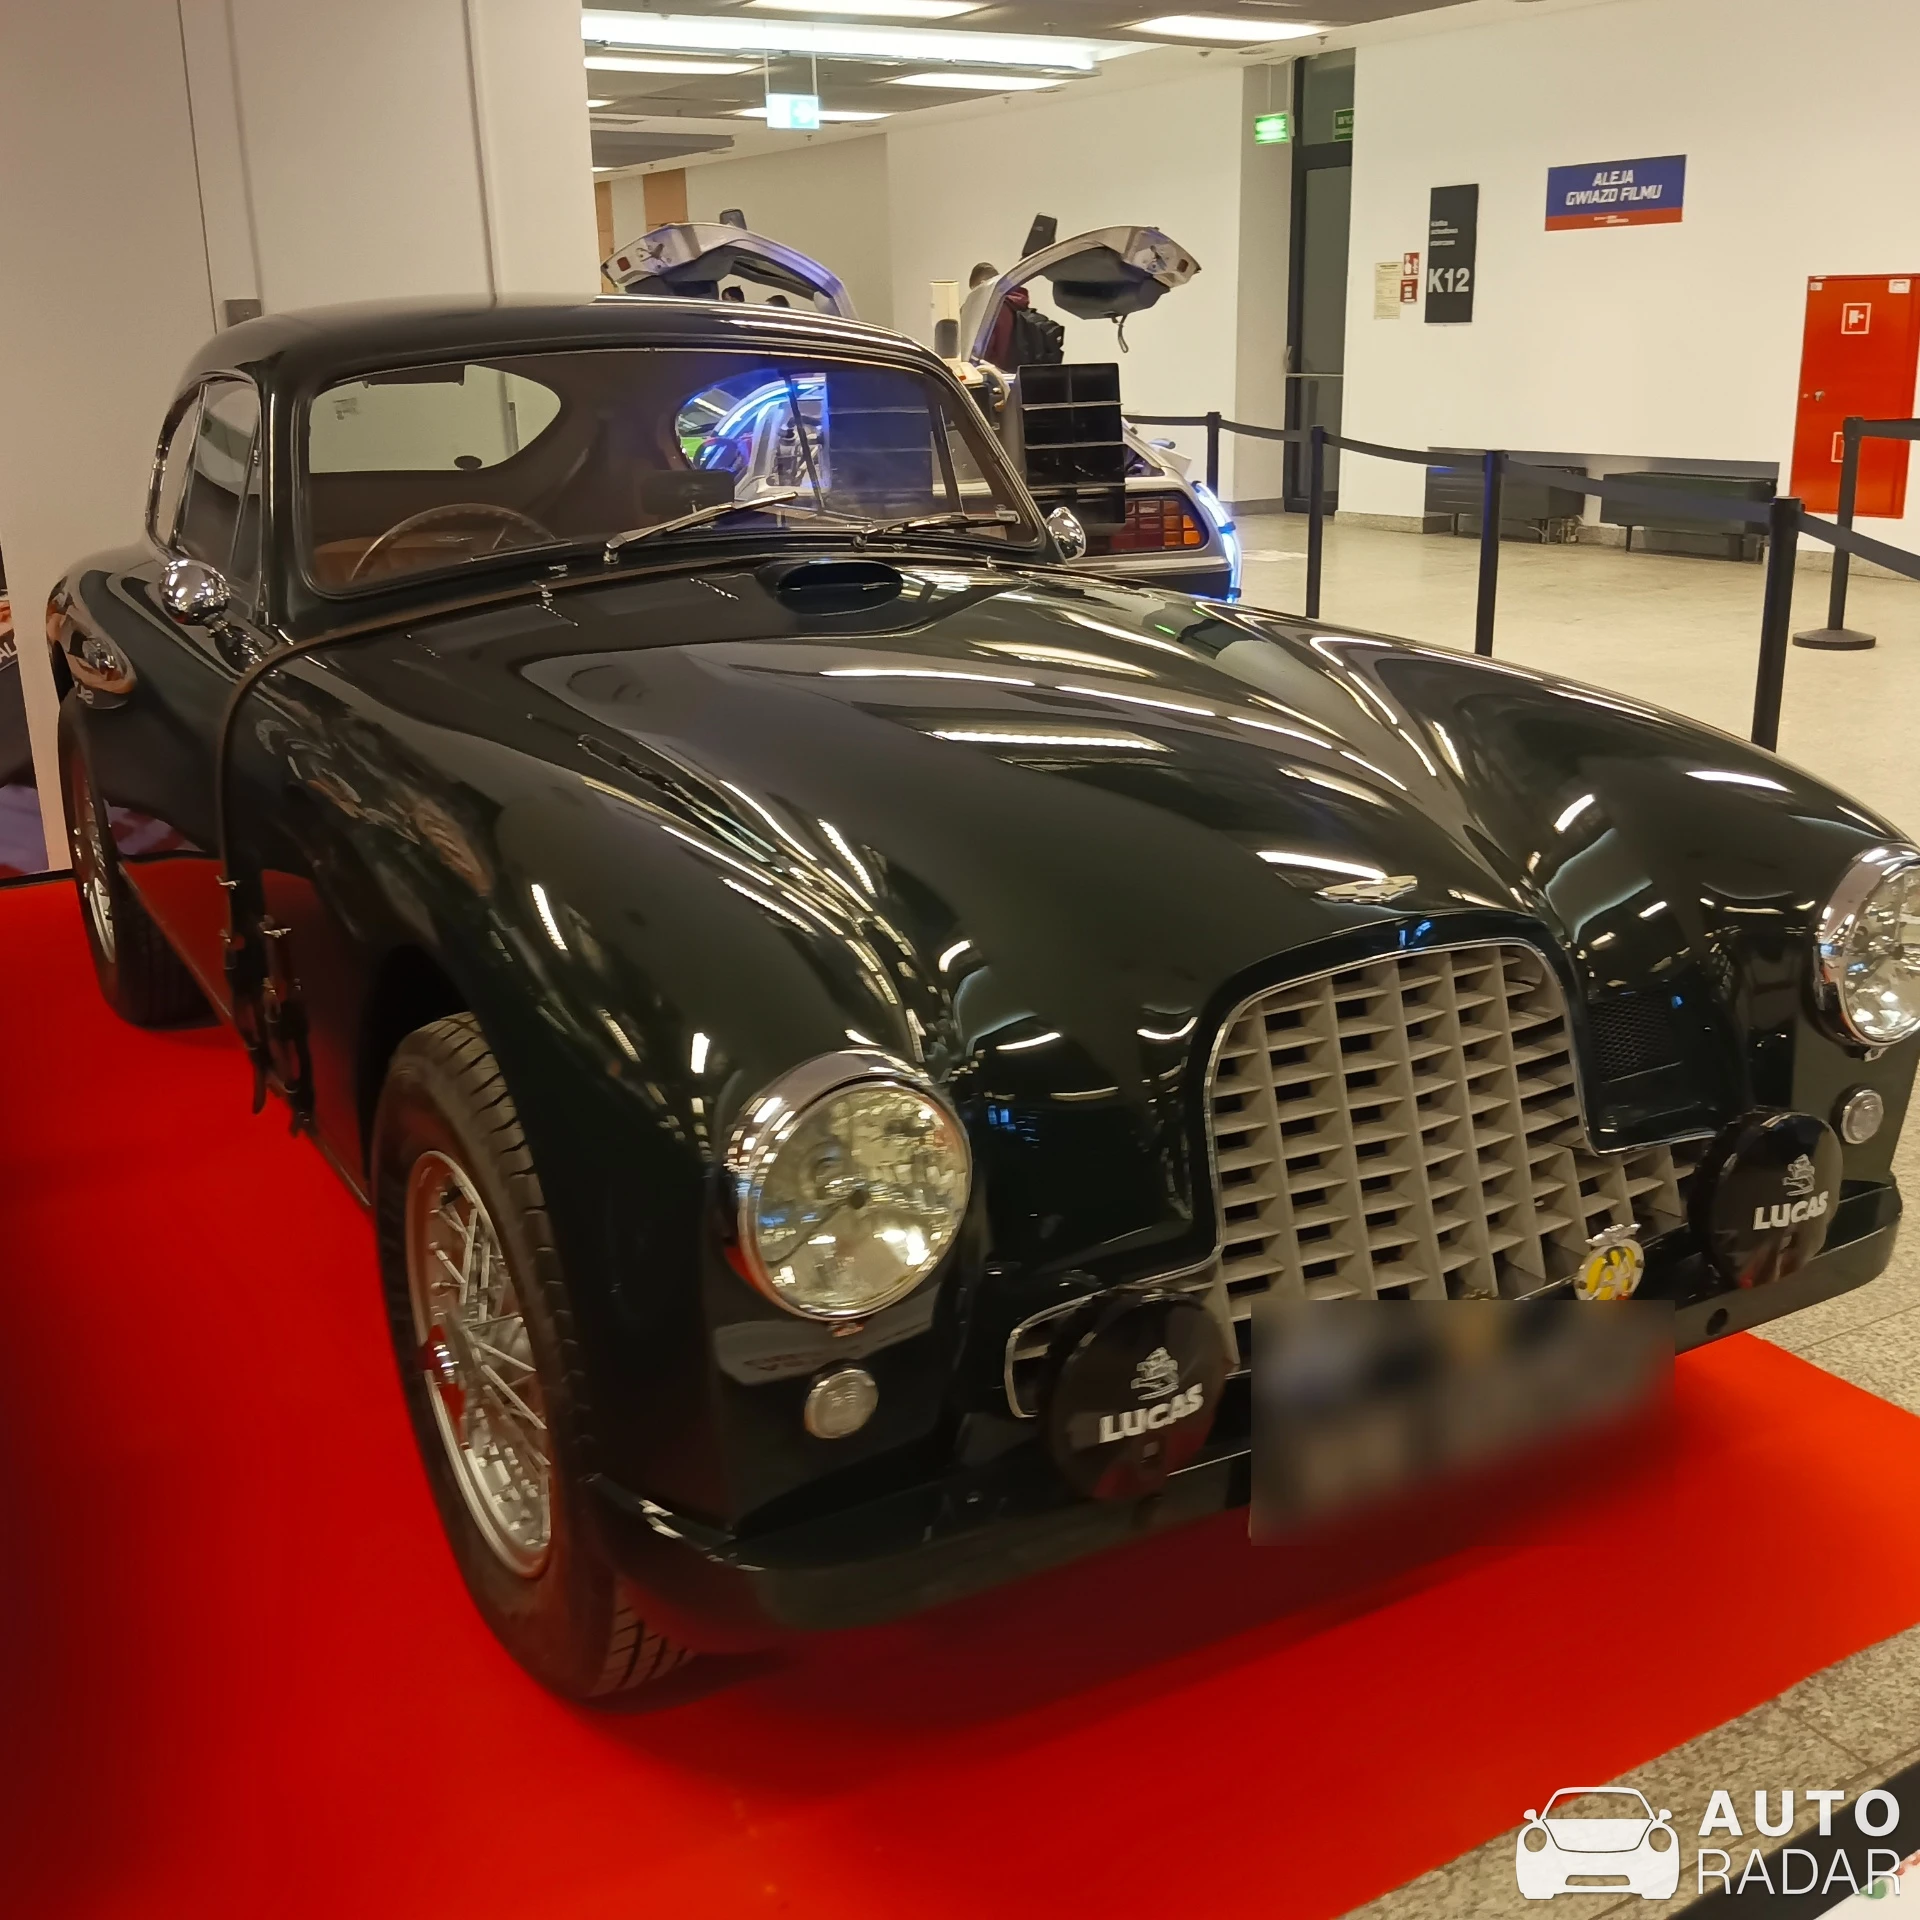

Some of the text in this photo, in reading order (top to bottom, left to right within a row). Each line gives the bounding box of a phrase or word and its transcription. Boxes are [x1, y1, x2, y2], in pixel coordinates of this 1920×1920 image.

[1592, 169, 1634, 187] ALEJA
[1565, 184, 1663, 206] GWIAZD FILMU
[1427, 267, 1470, 292] K12
[1753, 1191, 1829, 1230] LUCAS
[1098, 1382, 1204, 1444] LUCAS
